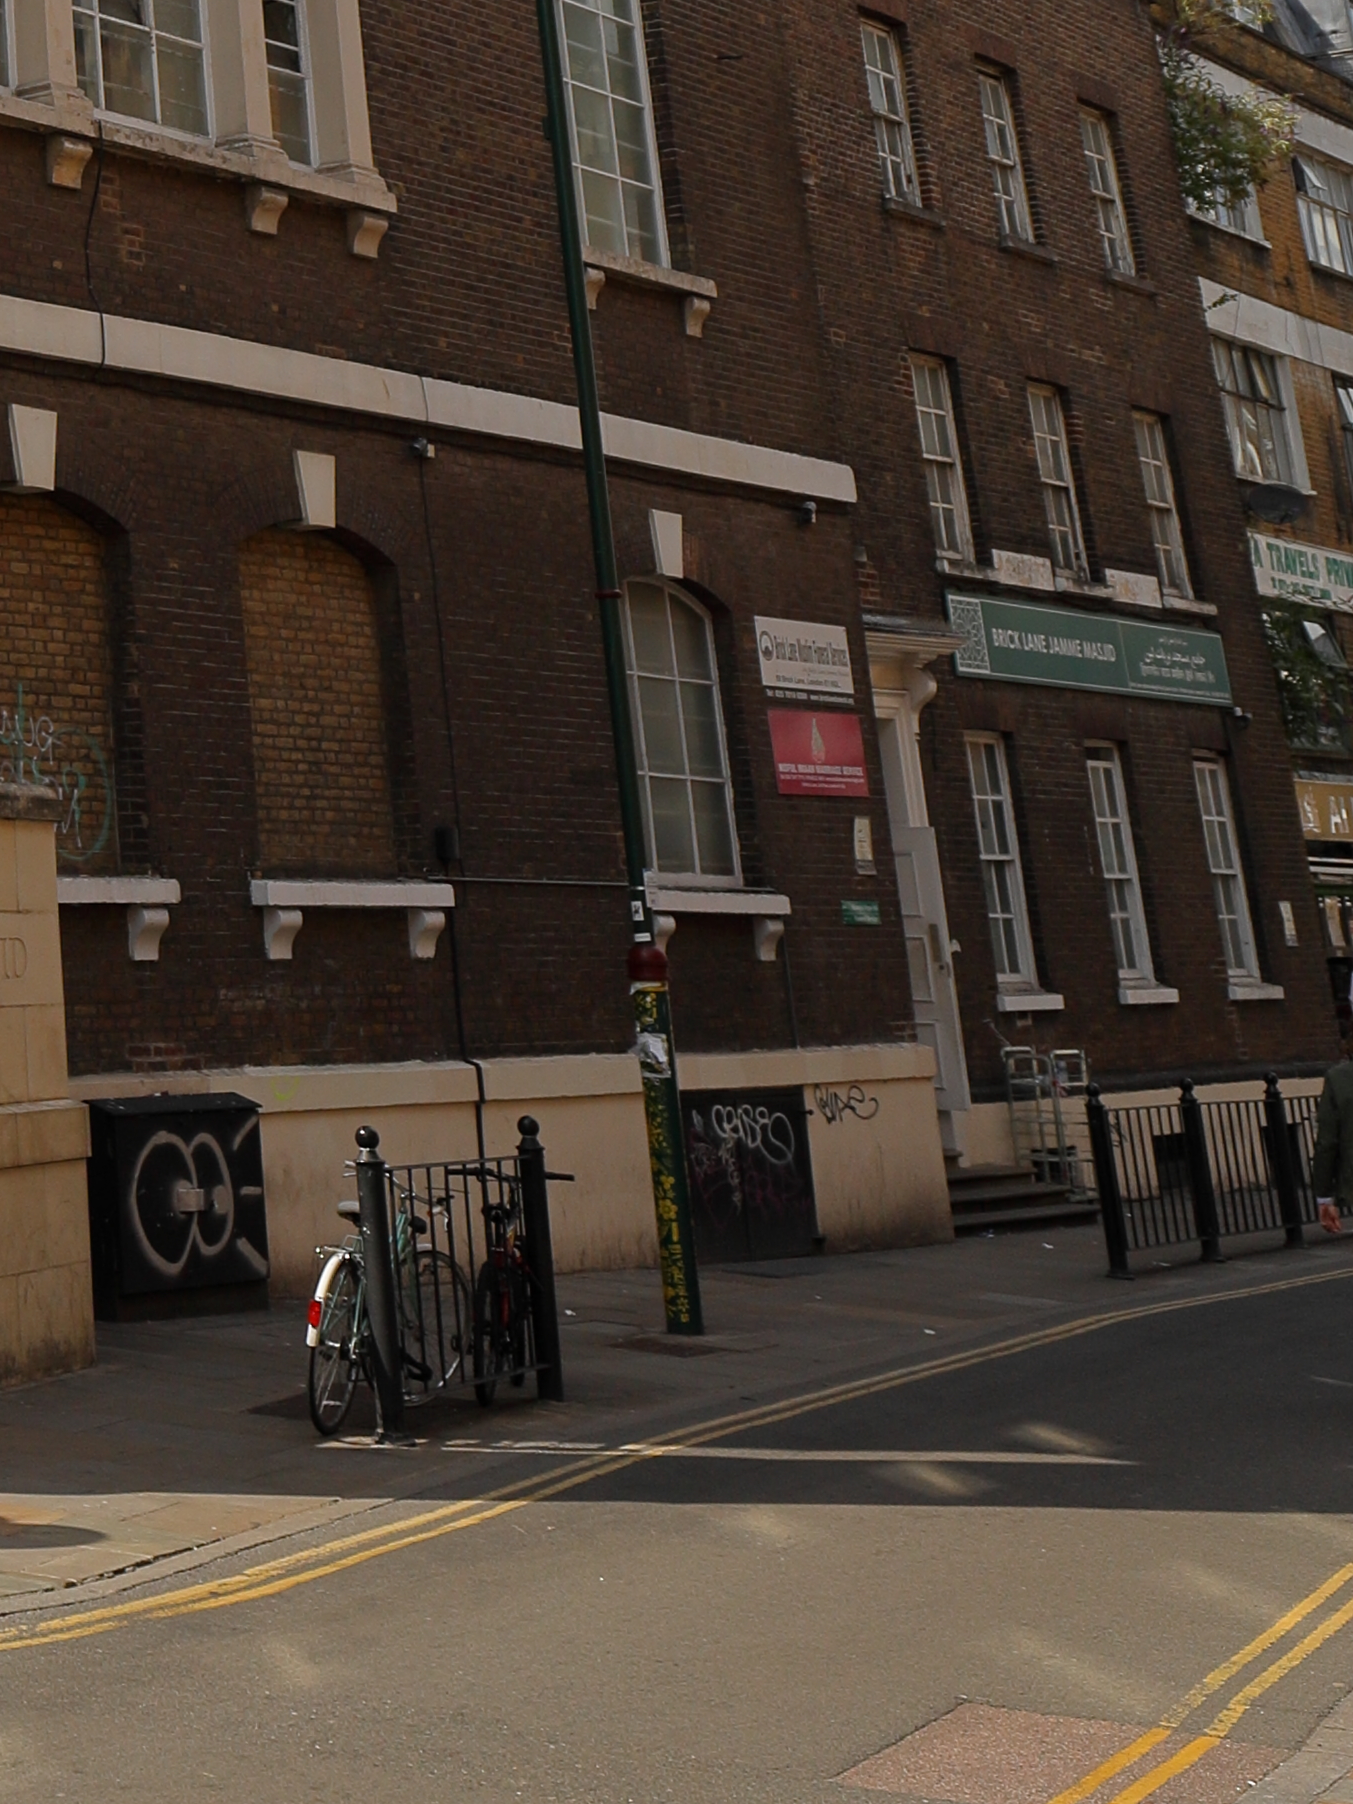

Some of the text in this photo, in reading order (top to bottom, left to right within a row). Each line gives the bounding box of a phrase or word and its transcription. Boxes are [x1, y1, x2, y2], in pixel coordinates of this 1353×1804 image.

[1265, 541, 1321, 582] TRAVELS
[991, 627, 1117, 662] BRICK LANE JAMME MASJID
